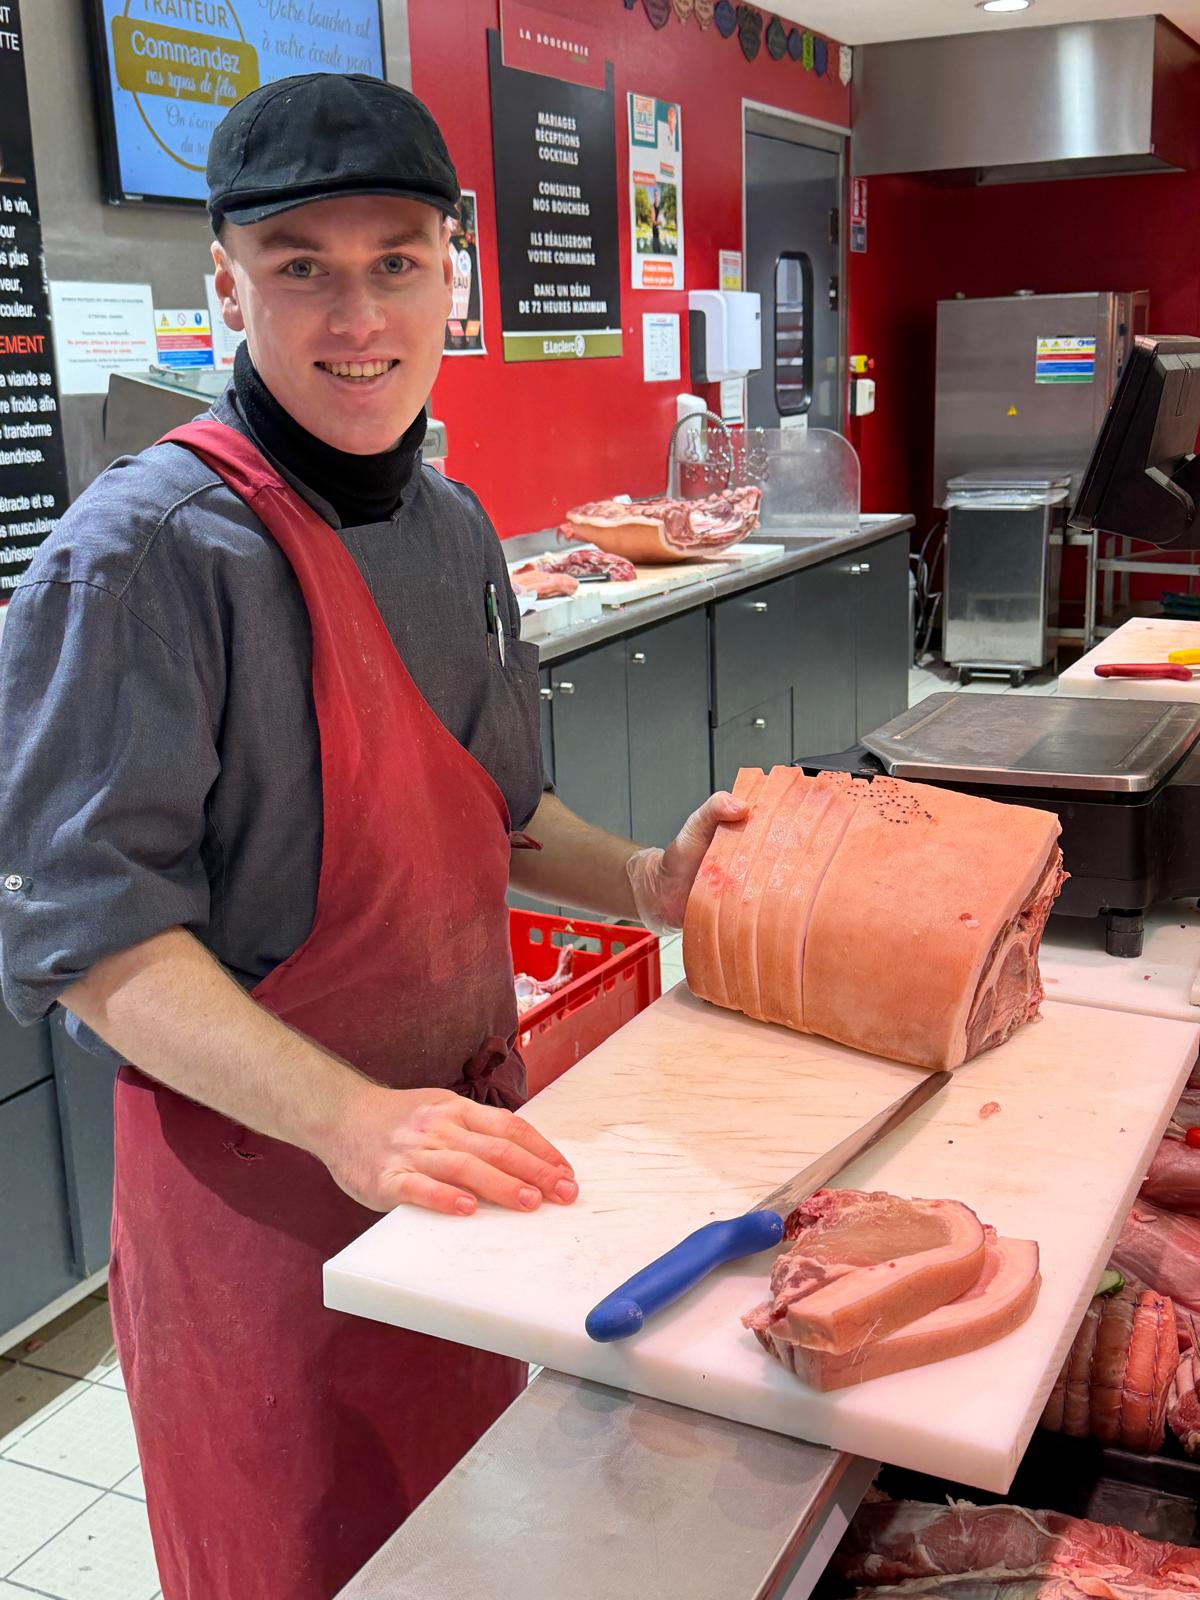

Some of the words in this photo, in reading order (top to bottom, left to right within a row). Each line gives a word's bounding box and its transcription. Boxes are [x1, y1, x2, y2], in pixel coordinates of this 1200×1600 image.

[131, 30, 240, 74] Commandez
[519, 28, 531, 40] LA
[537, 33, 589, 57] BOUCHERIE
[168, 71, 196, 97] repas
[200, 72, 212, 94] de
[538, 112, 577, 131] MARIAGES
[535, 128, 580, 148] RÉCEPTIONS
[539, 147, 579, 166] COCKTAILS
[539, 181, 581, 199] CONSULTER
[3, 195, 13, 213] le
[14, 197, 32, 216] vin,
[533, 198, 550, 212] NOS
[552, 200, 590, 216] BOUCHERS
[0, 225, 16, 238] our
[530, 232, 542, 246] ILS
[544, 229, 592, 249] RÉALISERONT
[9, 246, 29, 269] plus
[527, 249, 552, 264] VOTRE
[554, 251, 596, 266] COMMANDE
[534, 283, 555, 297] DANS
[557, 284, 568, 297] UN
[570, 281, 591, 297] DÉLAI
[519, 300, 530, 314] DE
[531, 300, 541, 314] 72
[543, 300, 571, 314] HEURES
[572, 301, 607, 314] MAXIMUM
[7, 370, 38, 387] viande
[39, 371, 52, 386] se
[11, 395, 38, 413] froide
[39, 394, 56, 412] afin
[4, 422, 53, 440] transforme
[31, 493, 42, 509] et
[42, 494, 55, 508] se
